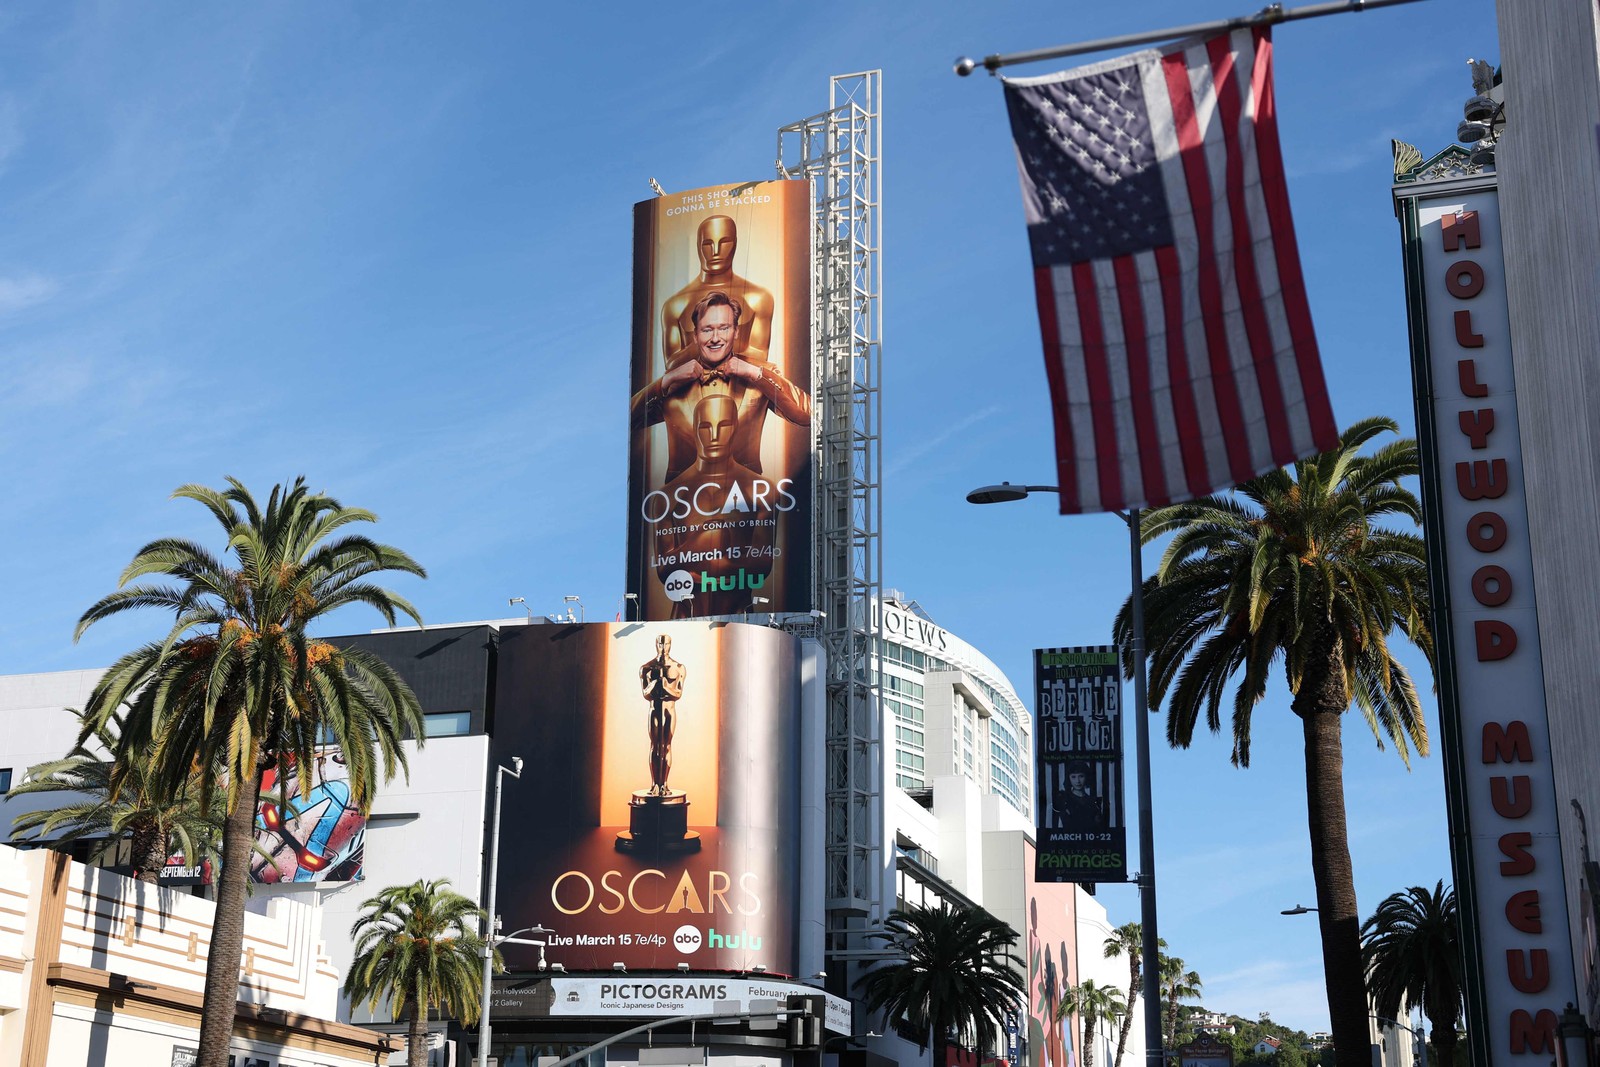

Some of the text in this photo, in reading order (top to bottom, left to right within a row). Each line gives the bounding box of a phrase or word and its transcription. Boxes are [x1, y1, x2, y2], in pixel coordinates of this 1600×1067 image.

[666, 195, 771, 216] GONNA BE STACKED
[682, 186, 754, 204] THIS SHOW IS
[641, 478, 796, 523] OSCARS
[656, 519, 776, 536] HOSTED BY CONAN O'BRIEN
[651, 545, 782, 568] Live March 15 7e/4p
[666, 568, 765, 593] abc hulu
[872, 603, 947, 653] LOEWS
[1441, 210, 1559, 1055] HOLLYWOOD MUSEUM
[1055, 666, 1103, 679] HOLLYWOOD
[1041, 686, 1116, 717] BEETLE
[1050, 833, 1081, 841] MARCH
[1039, 853, 1123, 868] PANTAGES
[551, 869, 761, 915] OSCARS
[548, 928, 762, 950] Live March 15 7e/4p abc hulu
[502, 987, 537, 995] Hollywood
[600, 984, 727, 999] PICTOGRAMS
[748, 986, 788, 1000] February
